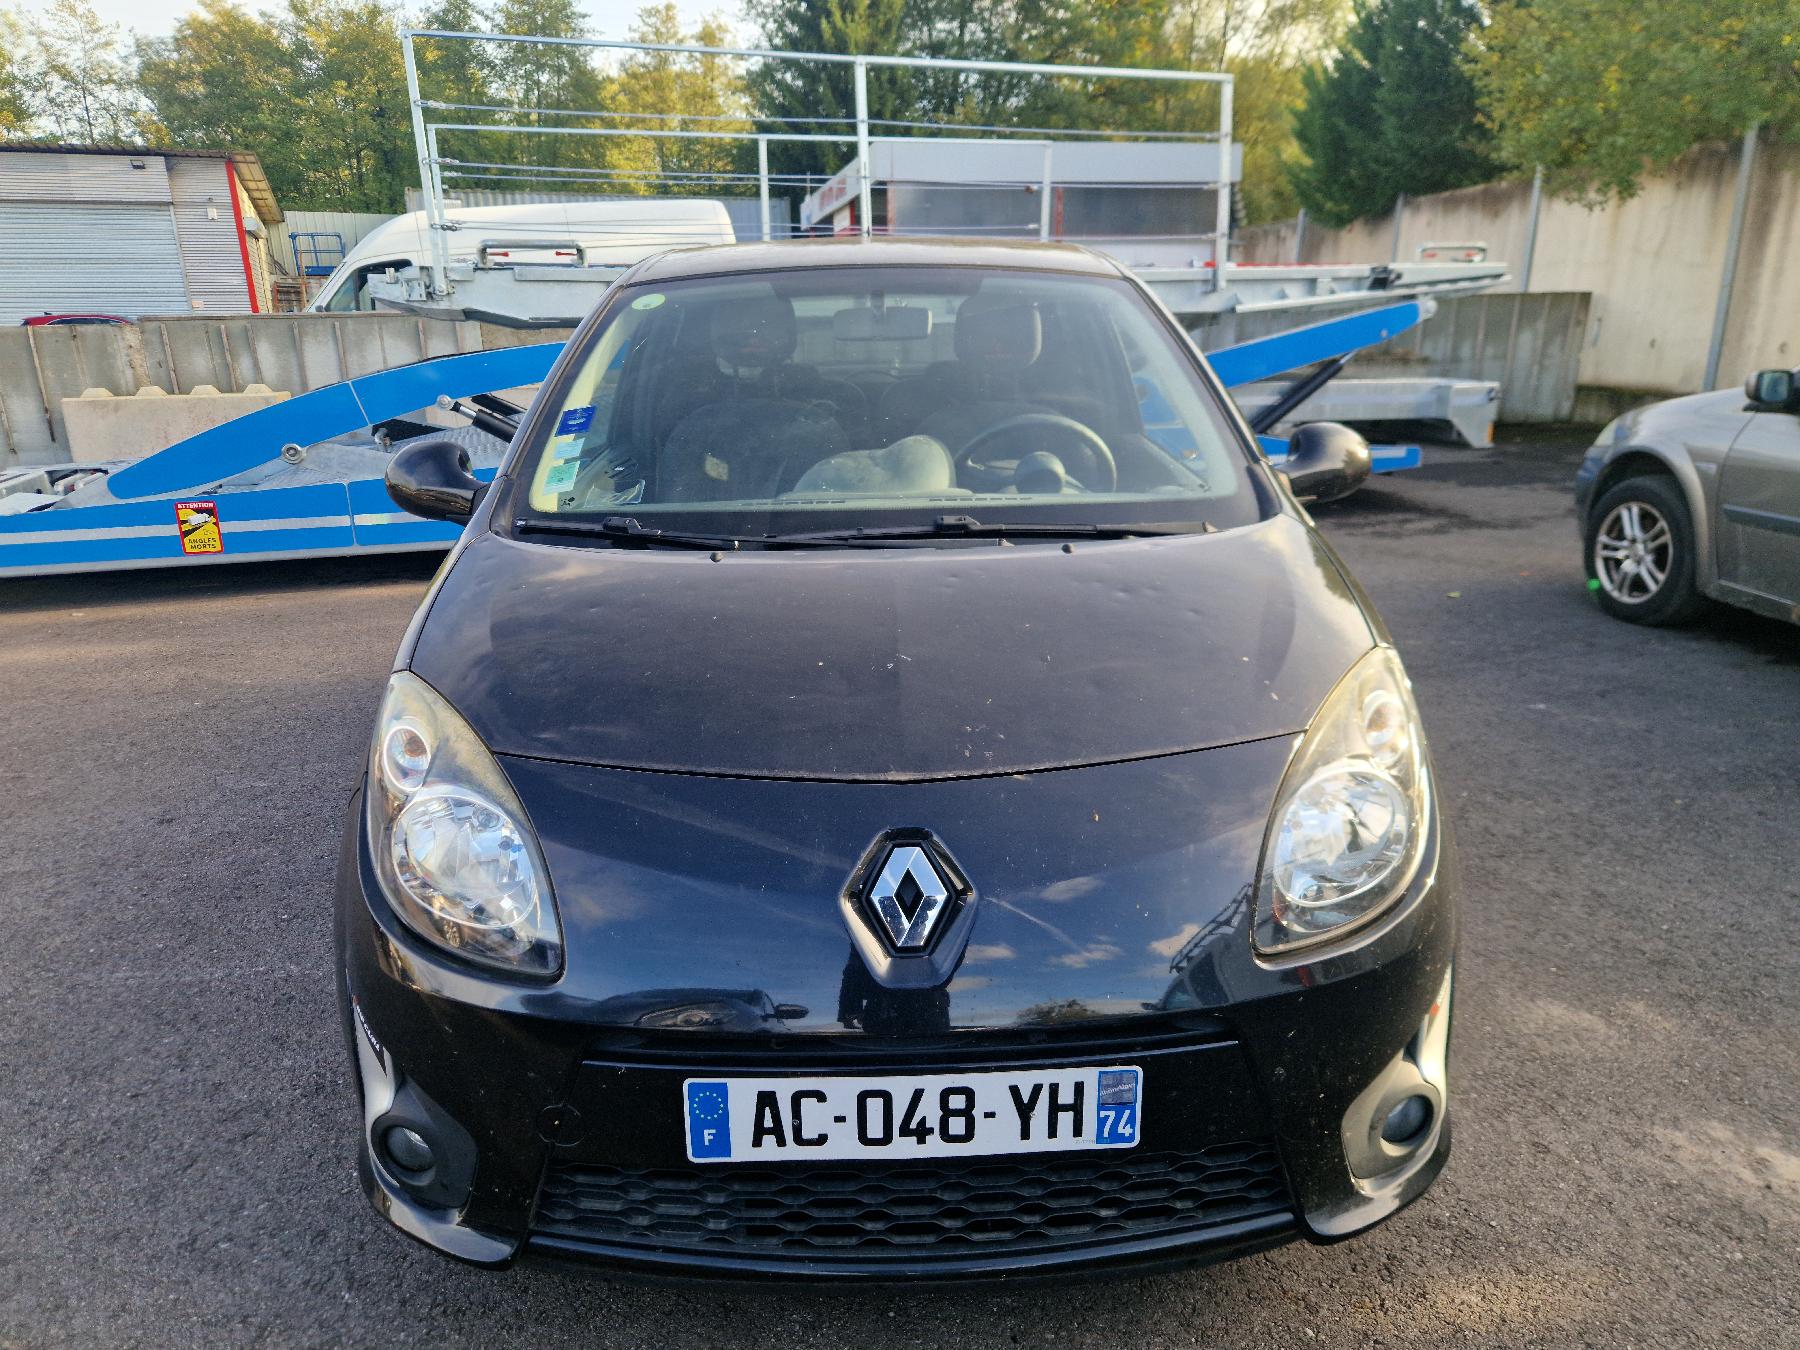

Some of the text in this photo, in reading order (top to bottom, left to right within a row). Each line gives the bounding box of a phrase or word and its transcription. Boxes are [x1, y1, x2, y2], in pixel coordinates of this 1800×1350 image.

[751, 1080, 1085, 1148] AC-048-YH
[1099, 1109, 1134, 1138] 74
[703, 1129, 717, 1146] F
